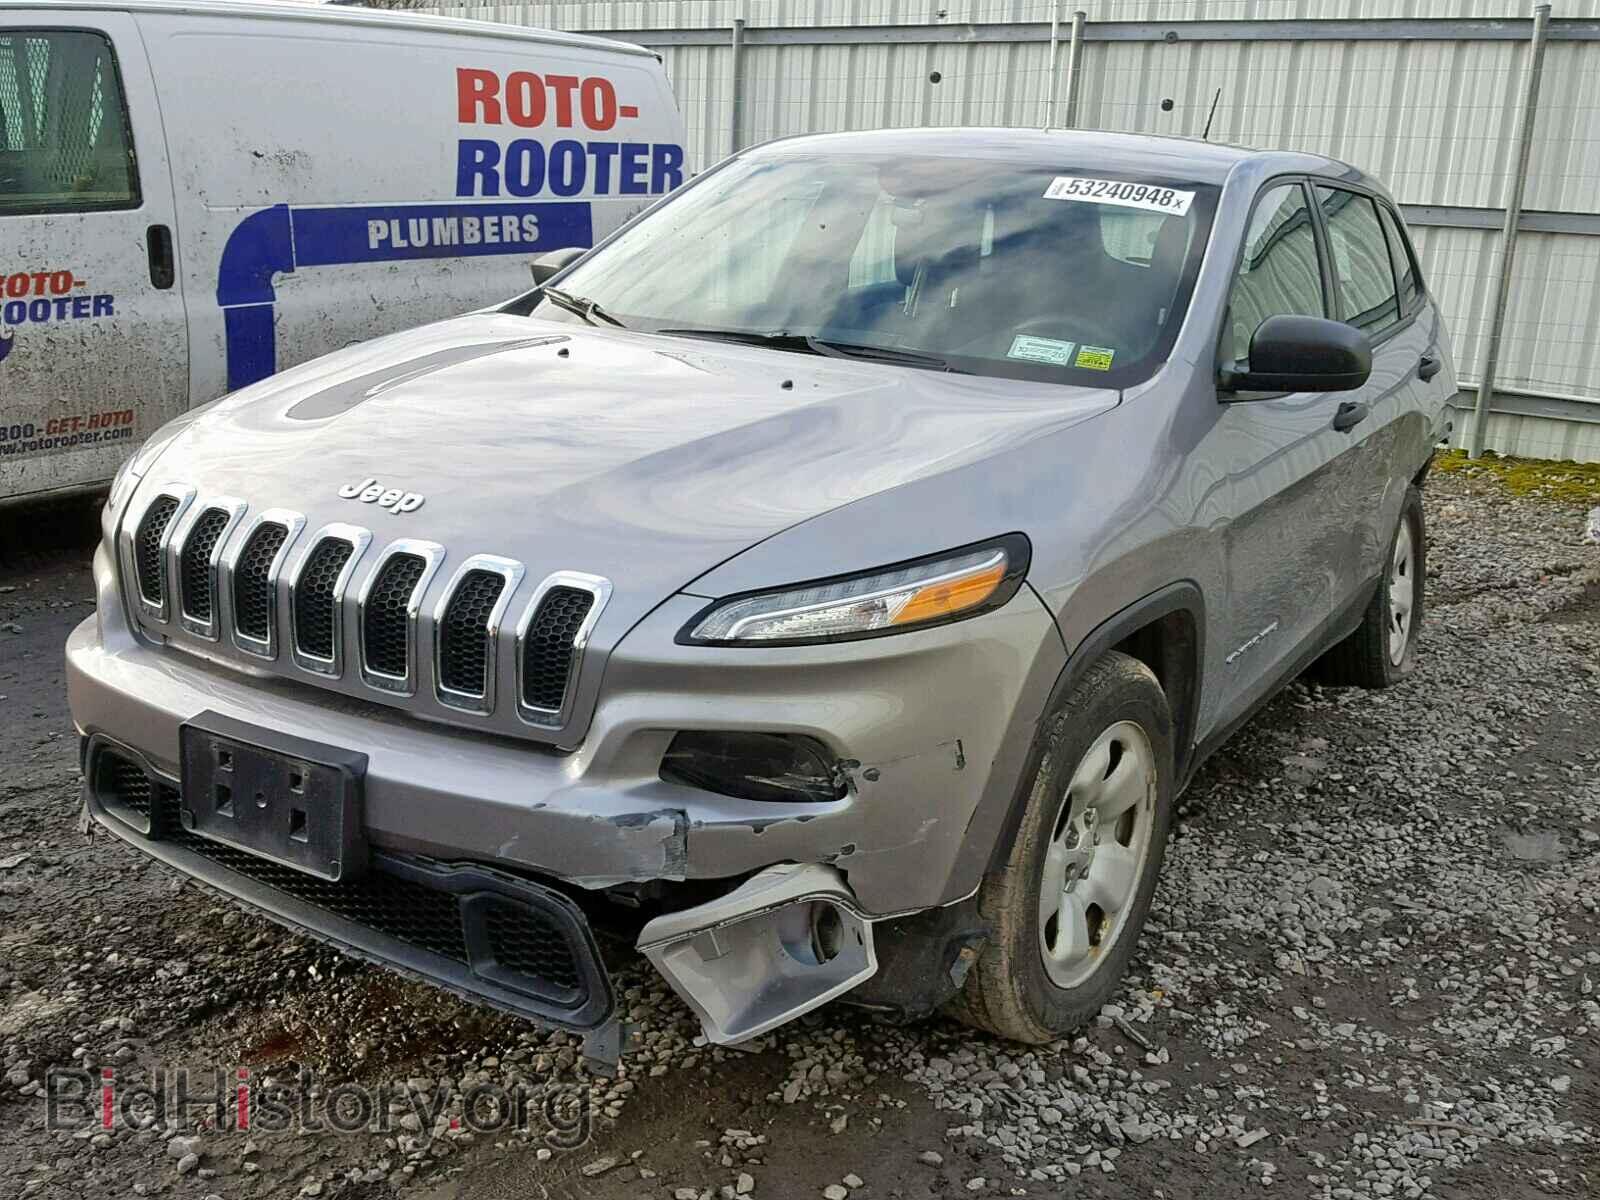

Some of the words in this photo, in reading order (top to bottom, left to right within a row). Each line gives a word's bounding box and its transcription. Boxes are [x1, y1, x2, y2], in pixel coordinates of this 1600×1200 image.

[456, 67, 638, 131] ROTO-
[456, 138, 683, 197] ROOTER
[367, 213, 540, 250] PLUMBERS
[0, 270, 86, 298] OTO-
[0, 294, 114, 325] OOTER
[338, 478, 425, 515] Jeep
